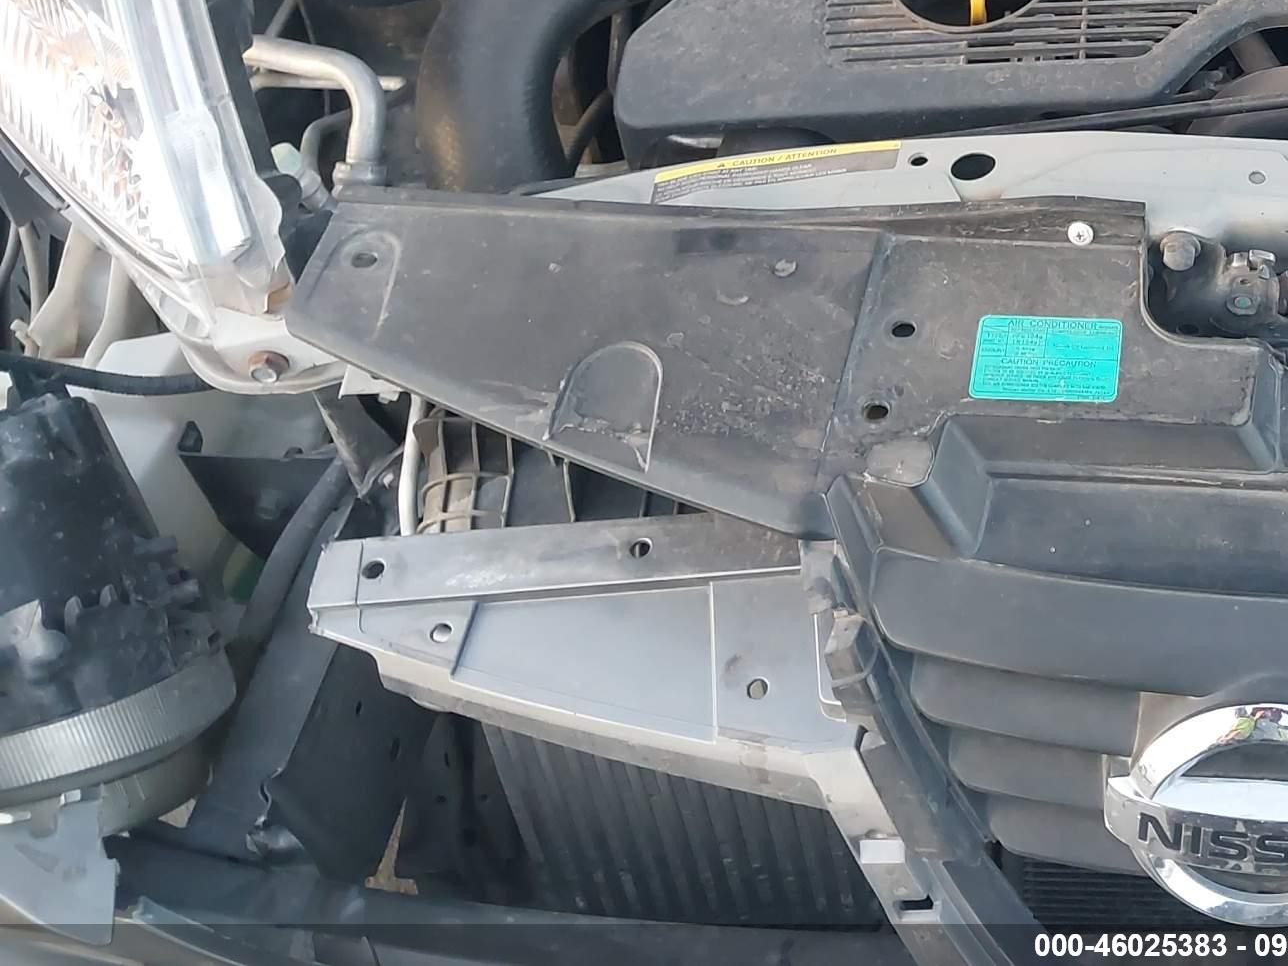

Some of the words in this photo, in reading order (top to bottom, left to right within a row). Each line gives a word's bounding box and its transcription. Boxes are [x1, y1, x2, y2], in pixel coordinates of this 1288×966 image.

[732, 156, 775, 167] CAUTION
[785, 148, 838, 161] ATTENTION
[1008, 319, 1026, 328] AIR
[1030, 320, 1097, 330] CONDITIONER
